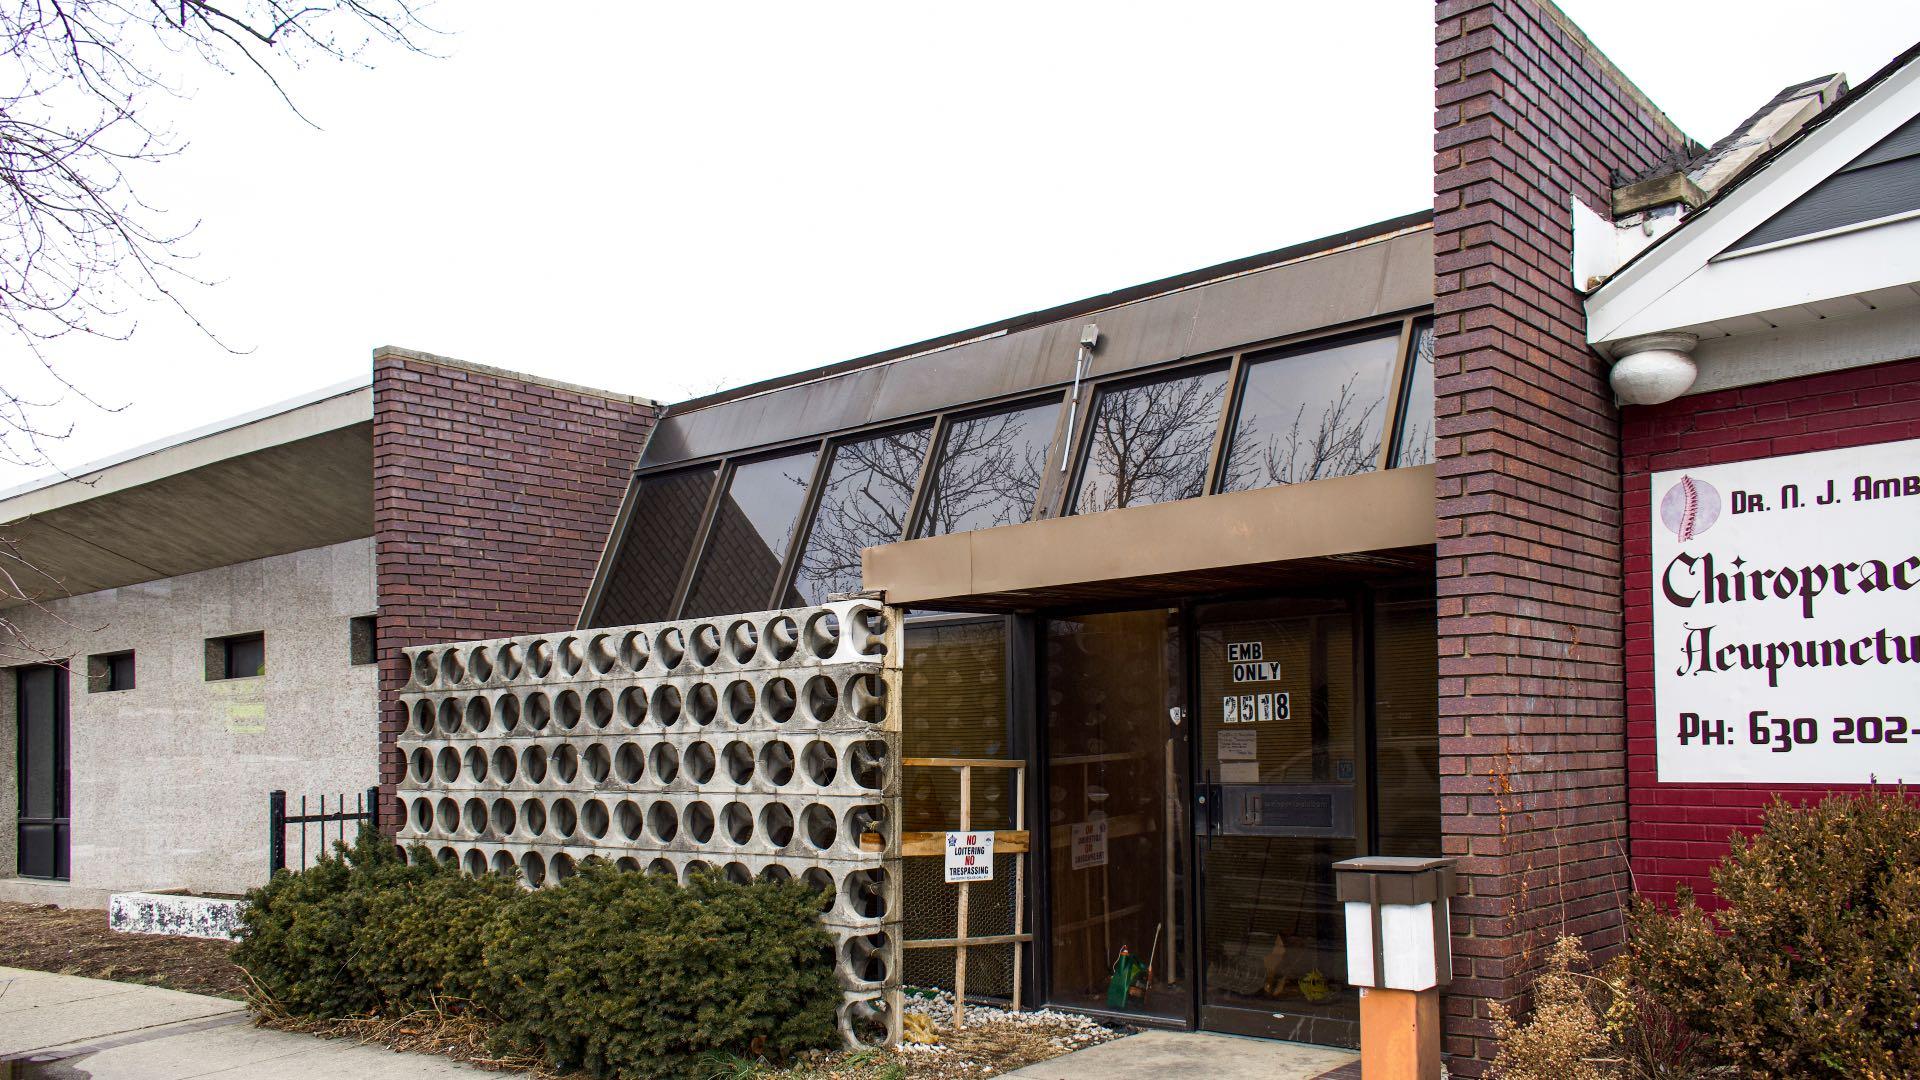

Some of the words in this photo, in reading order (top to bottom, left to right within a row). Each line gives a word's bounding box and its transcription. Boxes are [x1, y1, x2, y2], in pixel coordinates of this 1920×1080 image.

[1781, 484, 1805, 510] N.
[1816, 479, 1841, 505] J.
[1229, 643, 1261, 661] EMB
[1234, 662, 1279, 682] ONLY
[1749, 710, 1818, 753] 630
[967, 835, 977, 846] NO
[955, 847, 985, 855] LOITERING
[965, 856, 975, 866] NO
[949, 866, 989, 876] TRESPASSING
